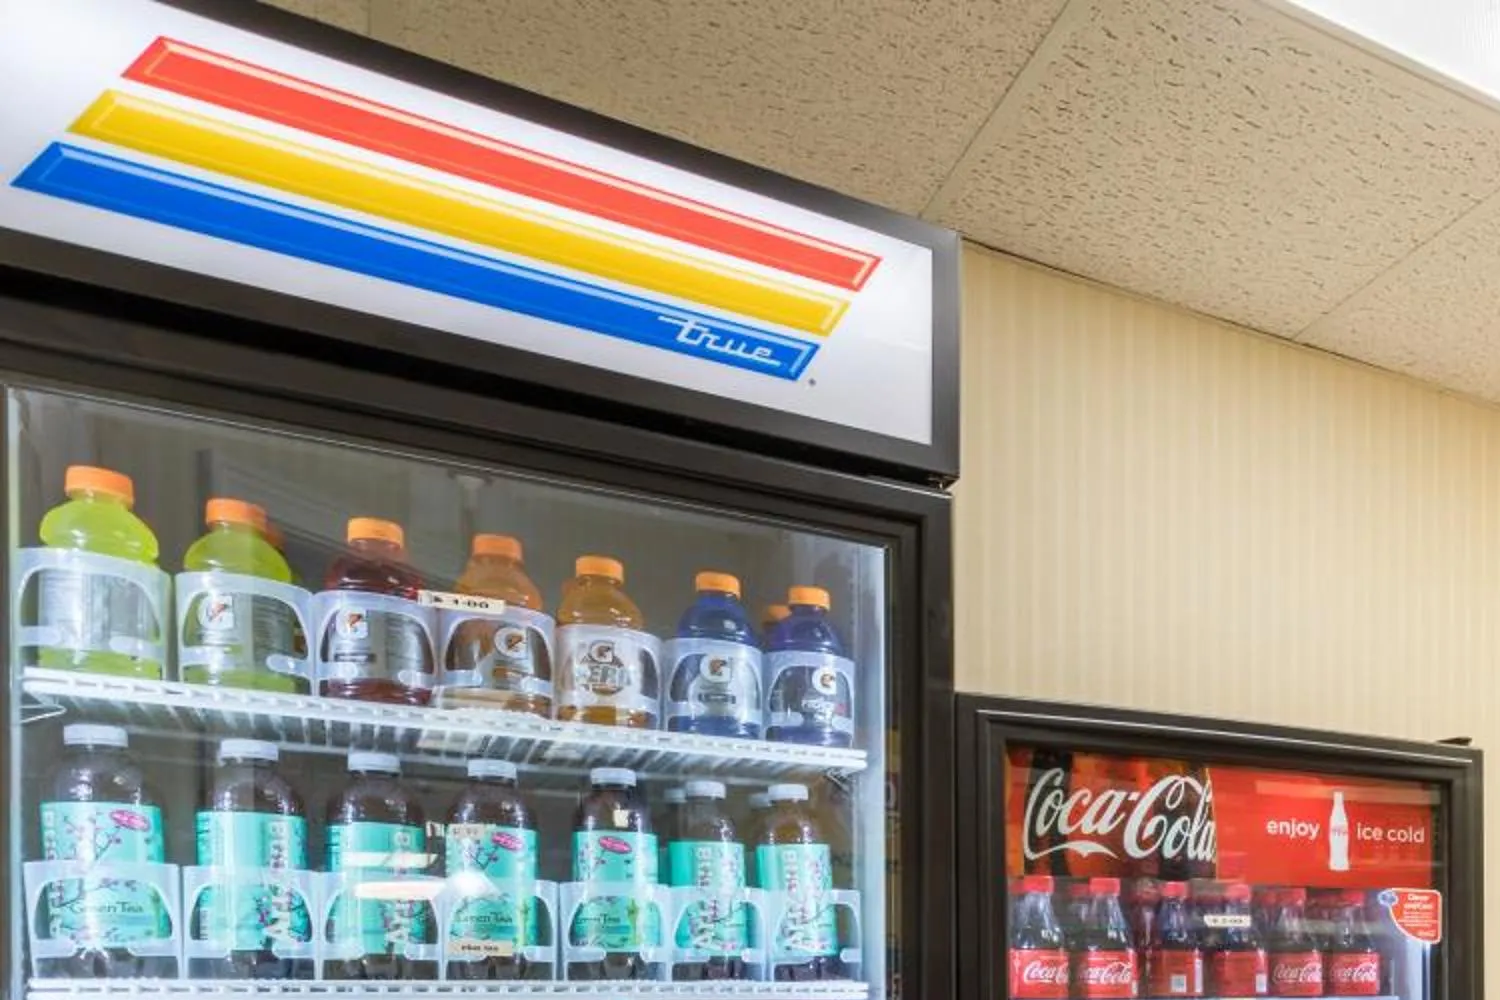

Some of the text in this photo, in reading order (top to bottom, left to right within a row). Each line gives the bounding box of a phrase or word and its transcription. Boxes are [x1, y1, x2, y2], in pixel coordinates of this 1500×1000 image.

[1266, 818, 1425, 844] enjoy ice cold
